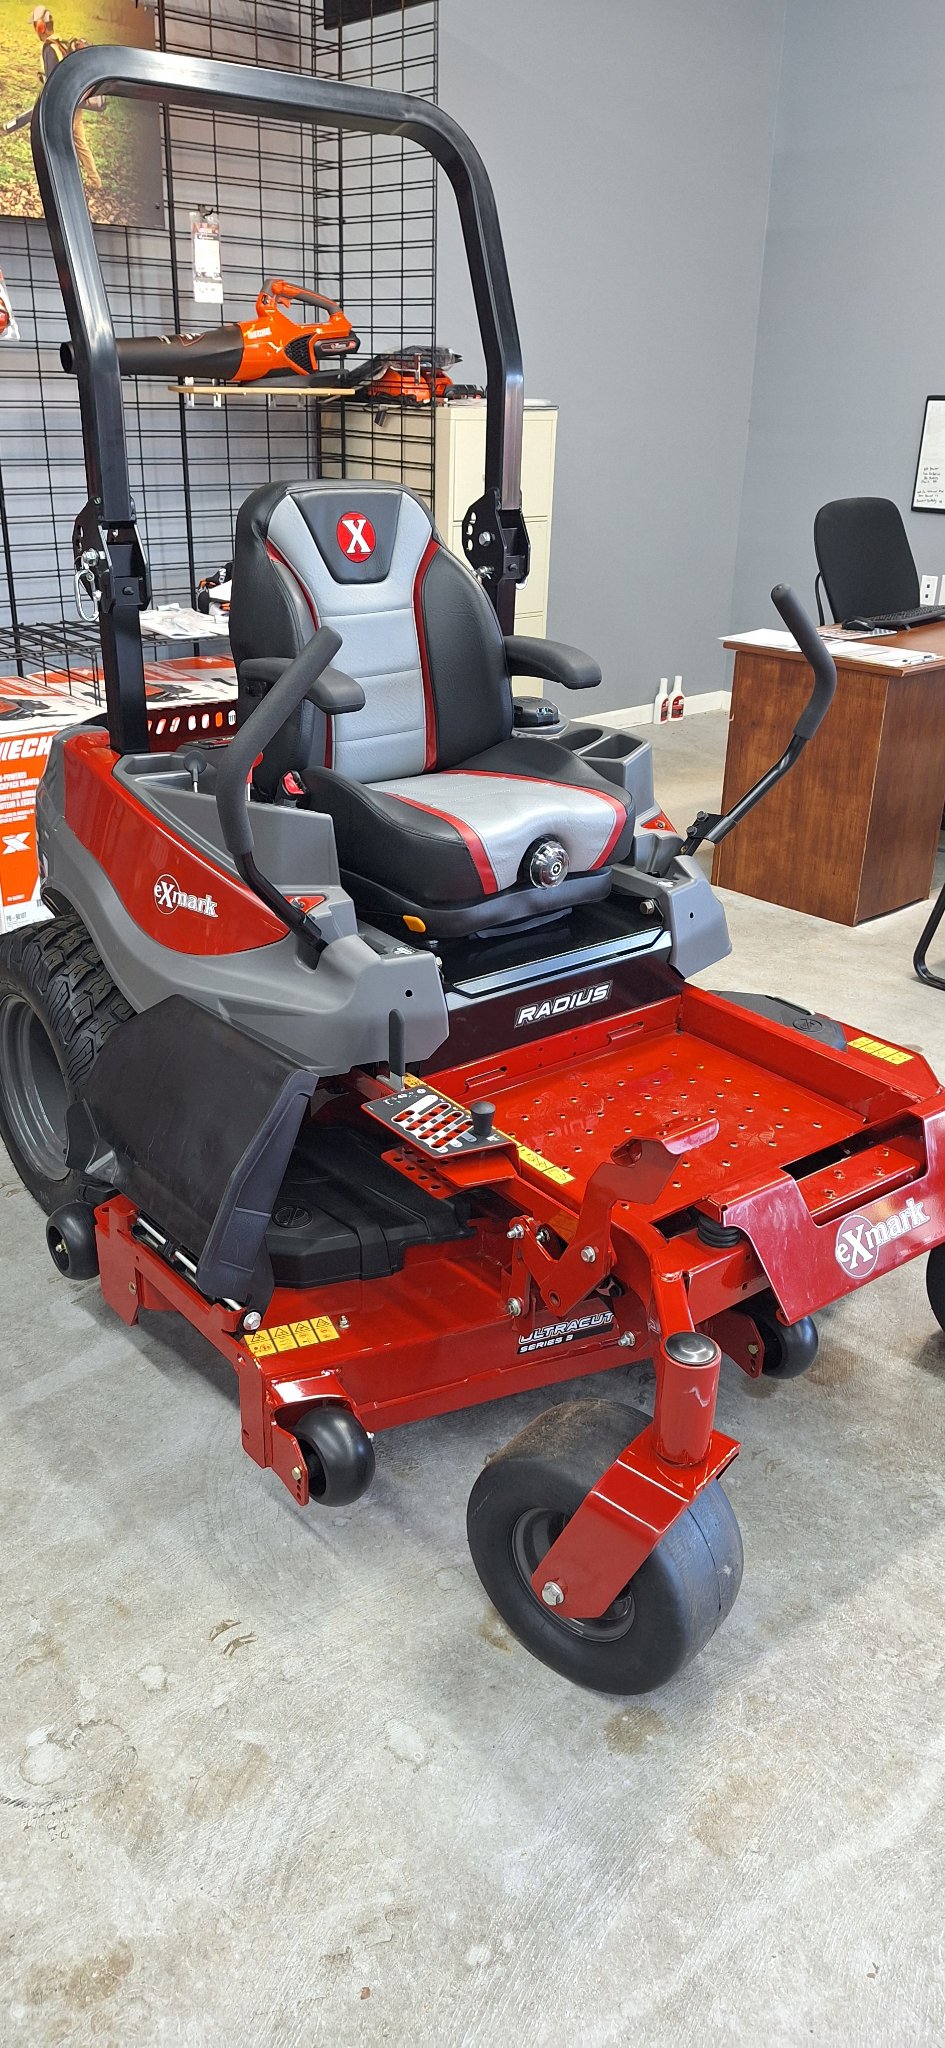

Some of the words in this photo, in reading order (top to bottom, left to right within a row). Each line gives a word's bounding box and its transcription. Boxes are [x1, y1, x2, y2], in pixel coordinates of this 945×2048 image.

[341, 519, 372, 554] X
[7, 735, 53, 760] ECH
[154, 880, 219, 918] eXmark
[517, 984, 609, 1025] RADIUS
[835, 1197, 931, 1270] eXmark
[519, 1311, 614, 1344] ULTRACUT
[519, 1336, 563, 1353] SERIES
